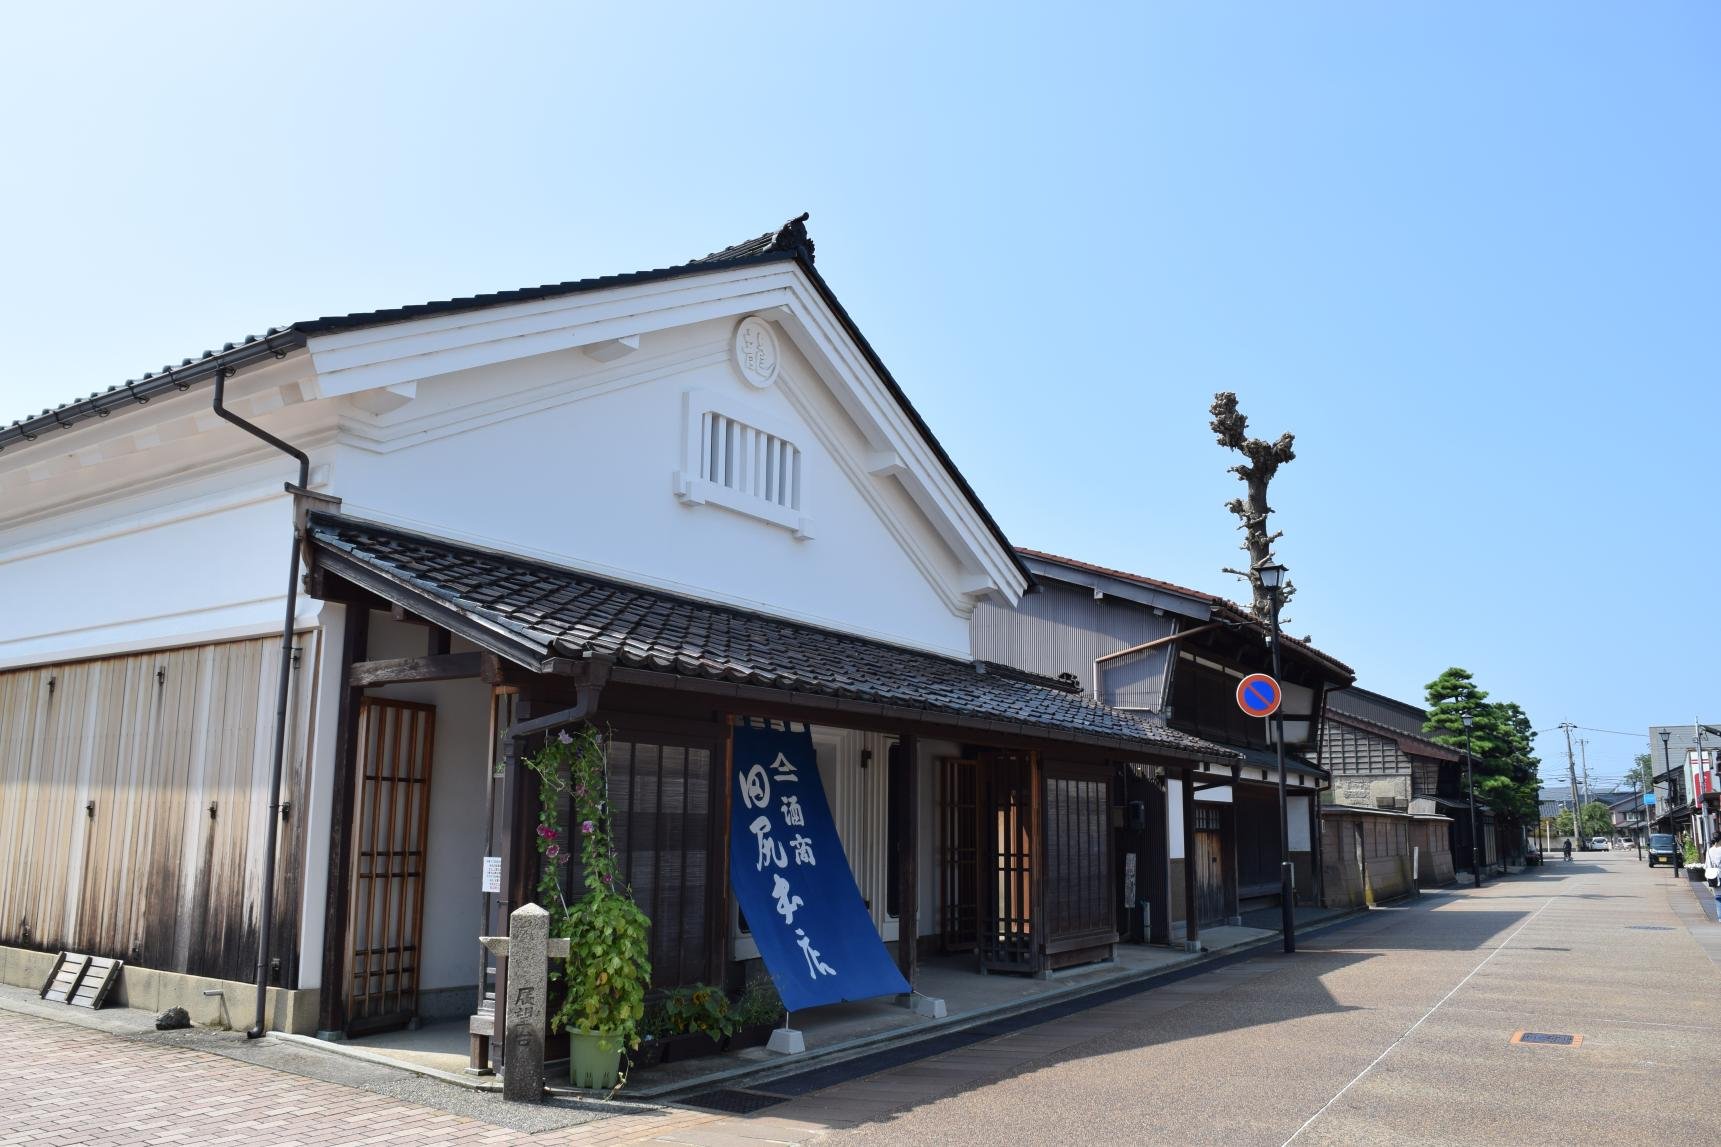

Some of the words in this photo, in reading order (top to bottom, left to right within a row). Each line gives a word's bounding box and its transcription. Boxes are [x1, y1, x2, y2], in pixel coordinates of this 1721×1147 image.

[780, 795, 817, 867] 酒商
[738, 762, 838, 981] 田尻本店
[513, 986, 535, 1047] 展望台
